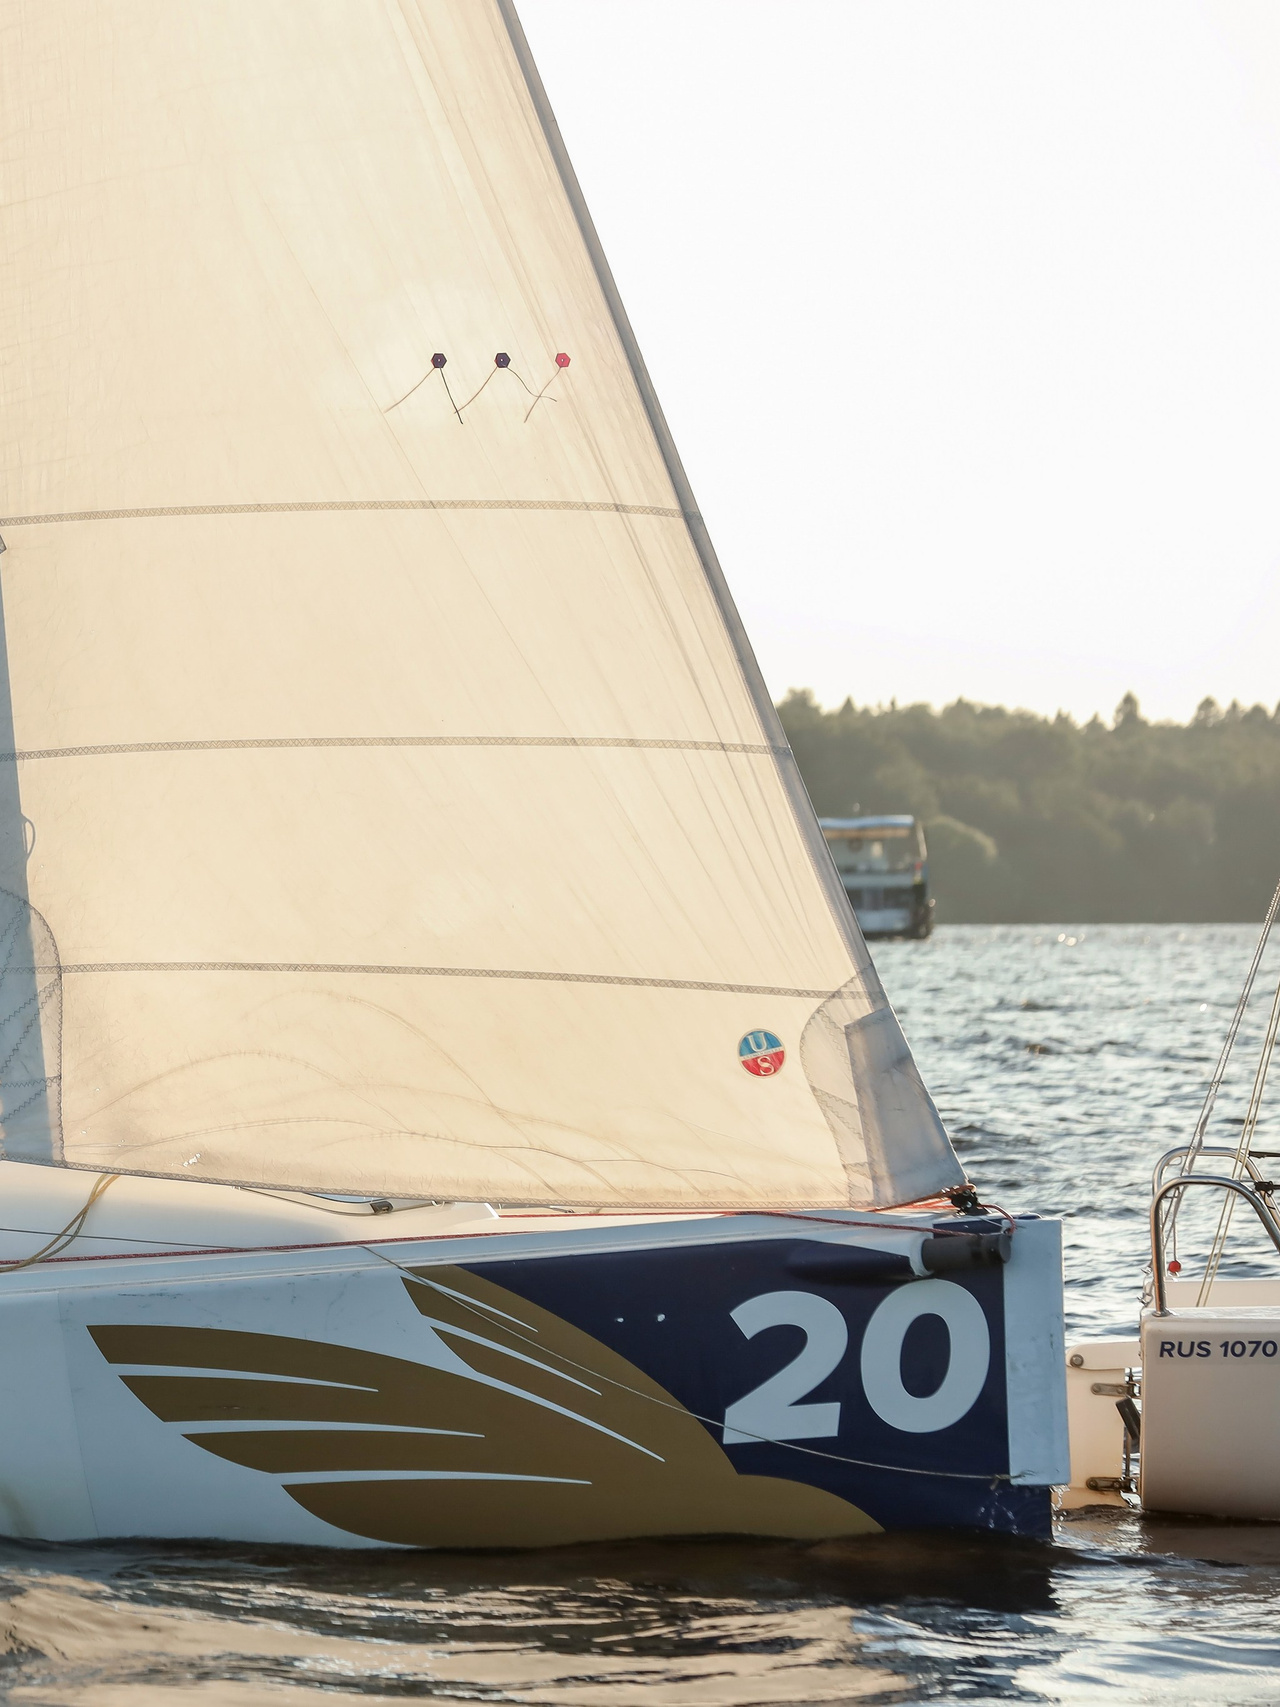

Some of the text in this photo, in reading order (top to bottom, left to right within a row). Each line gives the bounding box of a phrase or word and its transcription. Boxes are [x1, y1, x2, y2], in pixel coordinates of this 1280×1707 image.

[722, 1280, 991, 1445] 20
[1159, 1340, 1278, 1358] RUS 1070
